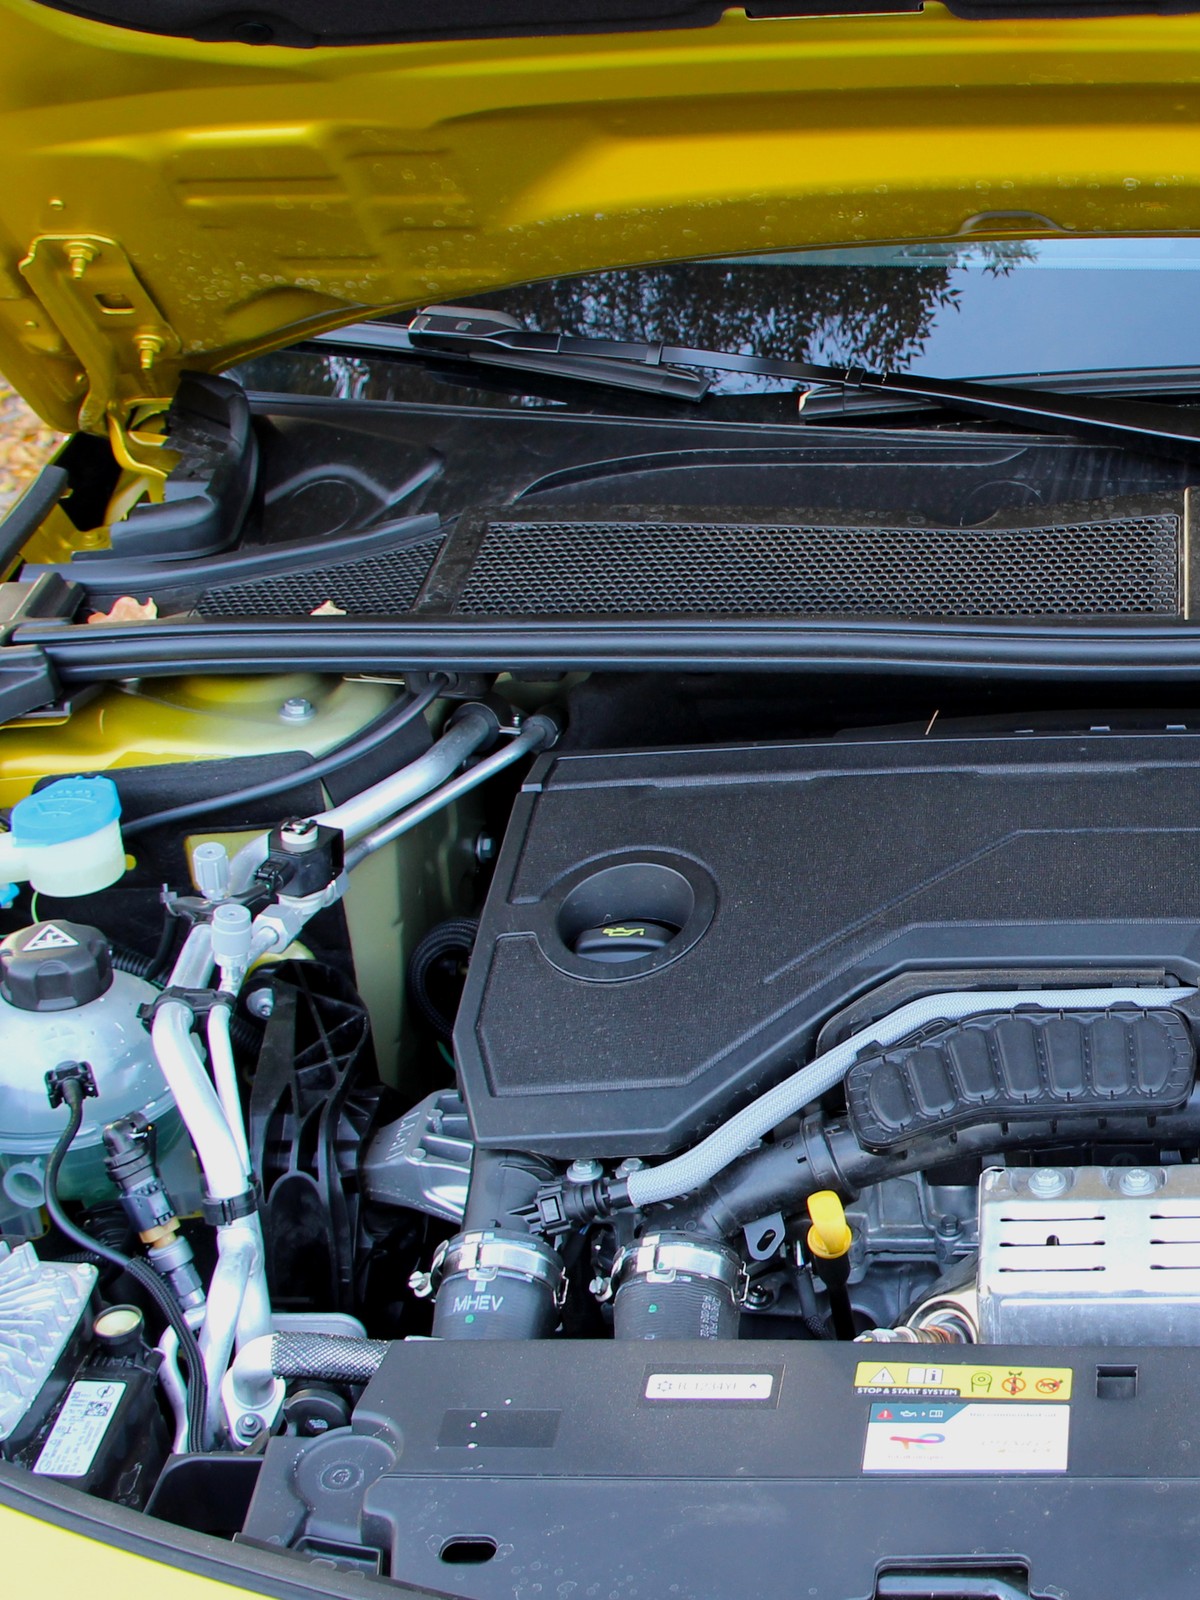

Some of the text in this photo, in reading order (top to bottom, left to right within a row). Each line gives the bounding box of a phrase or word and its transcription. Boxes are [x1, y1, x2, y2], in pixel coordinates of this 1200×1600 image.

[453, 1294, 504, 1313] MHEV
[883, 1387, 890, 1395] &
[891, 1387, 921, 1395] START
[922, 1388, 958, 1396] SYSTEM
